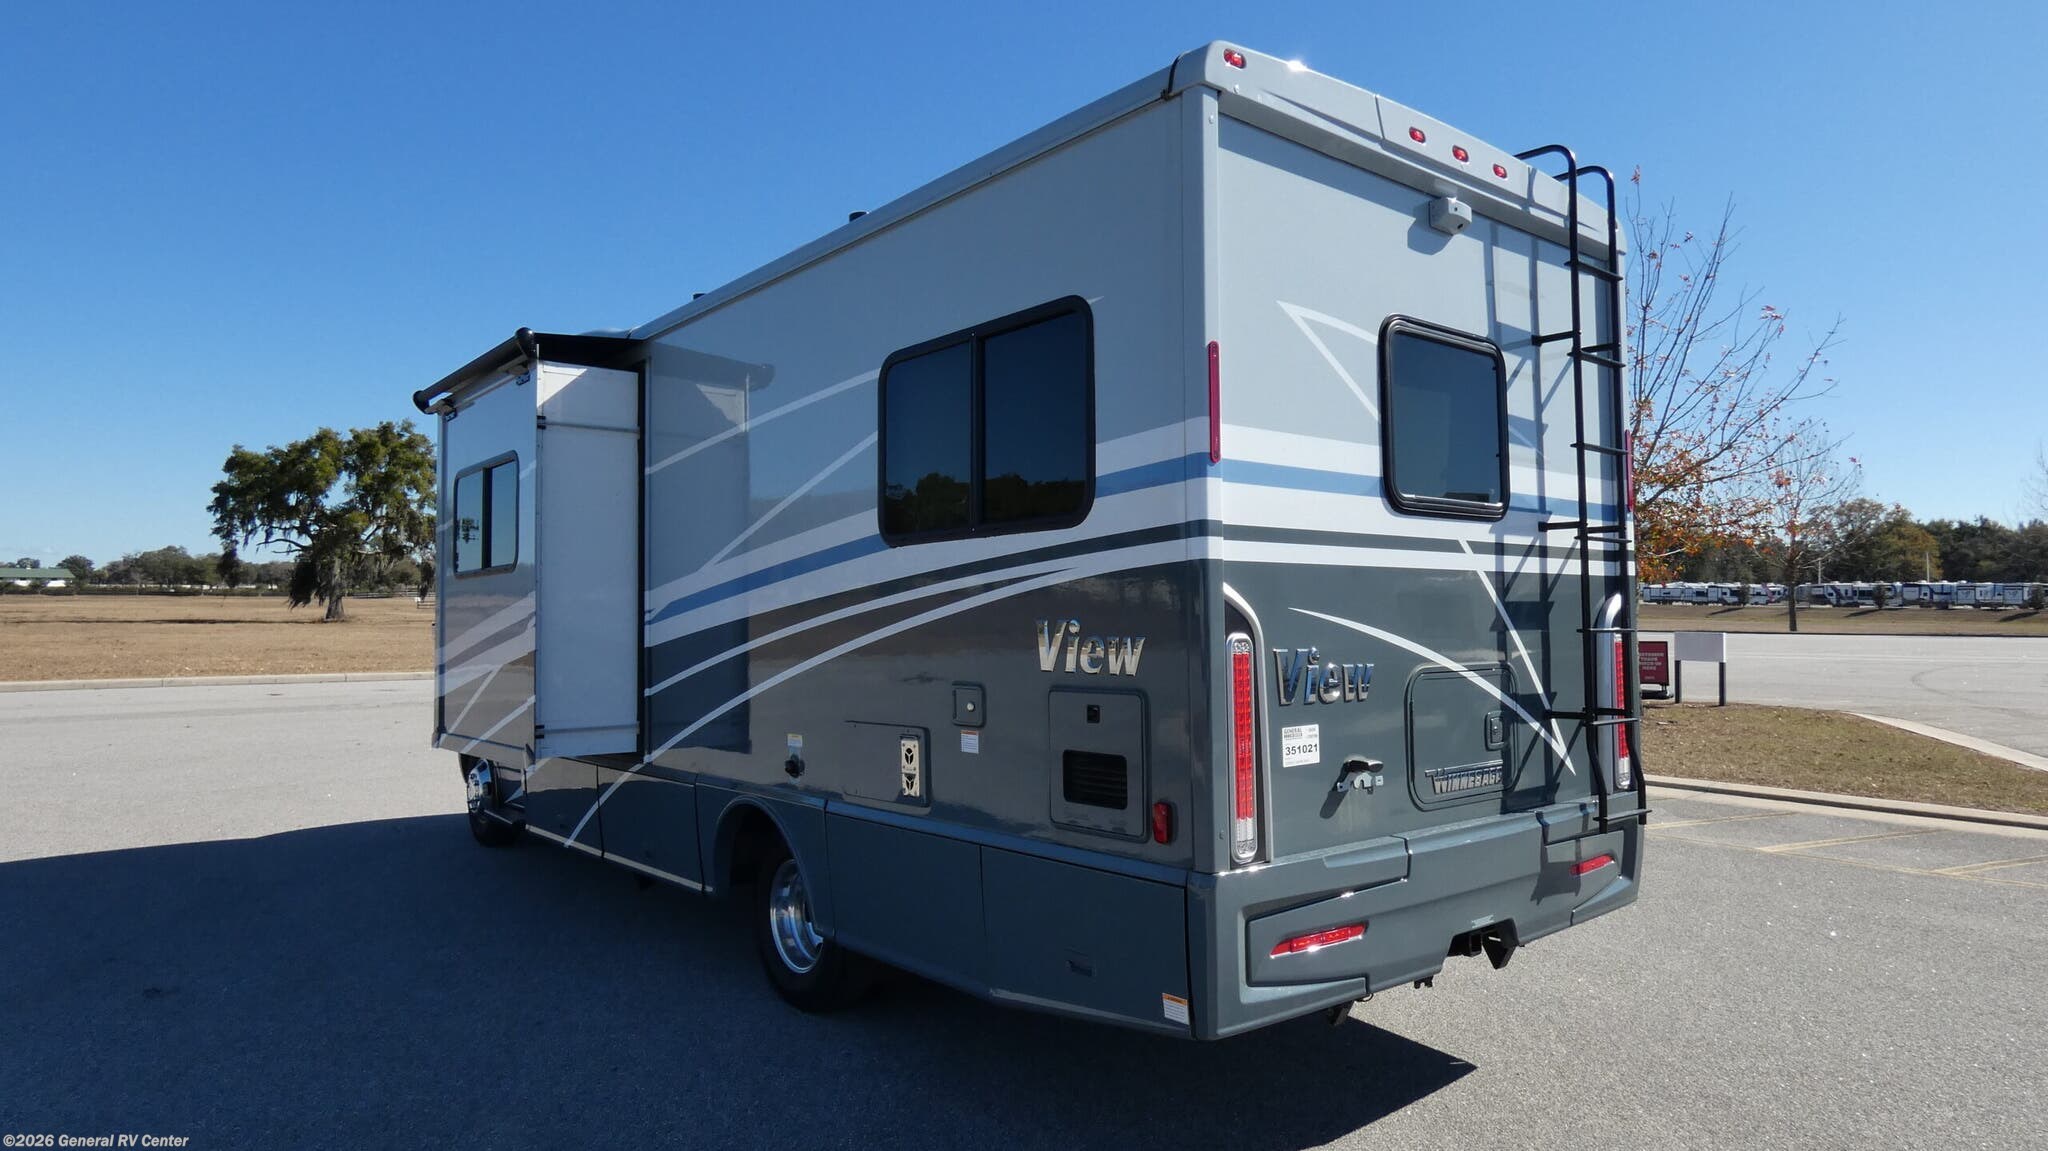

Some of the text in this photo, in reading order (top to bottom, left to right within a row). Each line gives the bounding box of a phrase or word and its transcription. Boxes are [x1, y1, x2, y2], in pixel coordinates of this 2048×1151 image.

[1036, 619, 1146, 676] View
[1272, 647, 1374, 706] View
[1285, 743, 1318, 756] 351021
